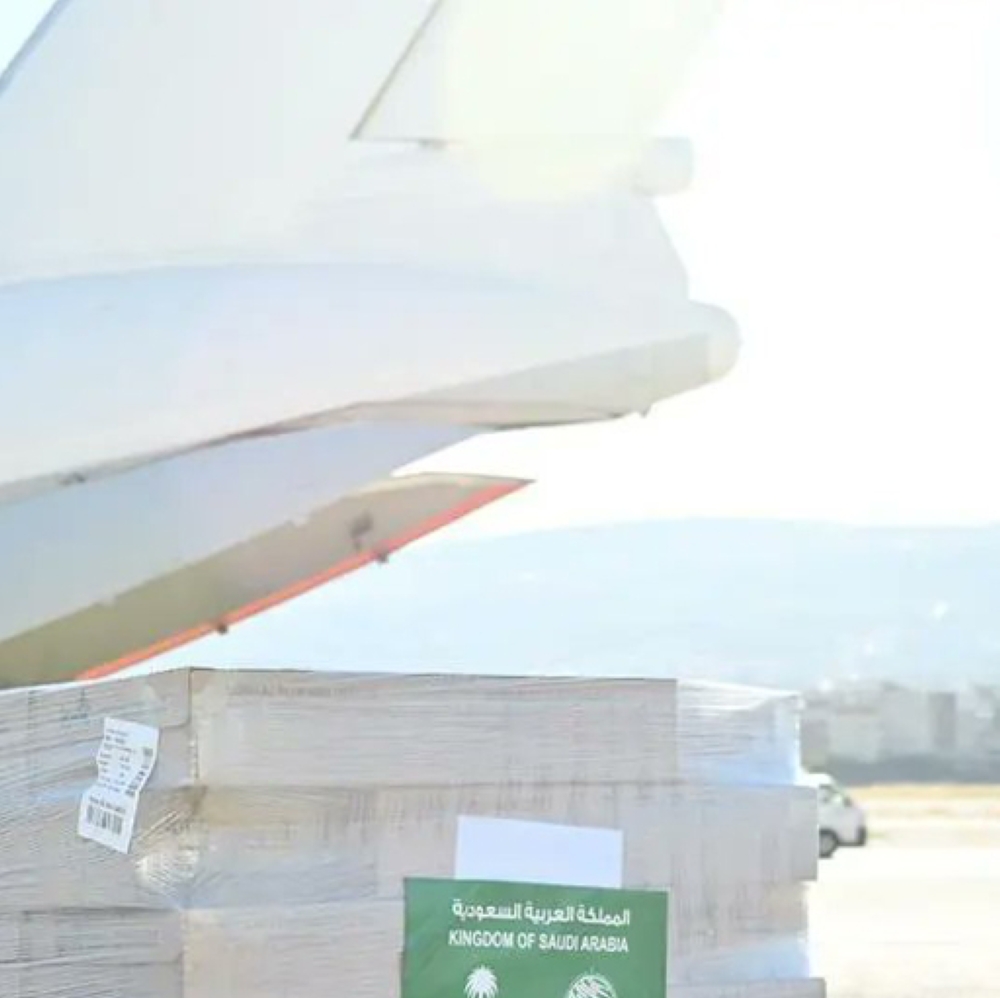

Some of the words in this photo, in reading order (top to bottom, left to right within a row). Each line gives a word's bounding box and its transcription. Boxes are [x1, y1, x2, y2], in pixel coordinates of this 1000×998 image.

[452, 898, 522, 921] السعودية
[524, 901, 575, 924] العربية
[576, 904, 630, 926] المملكة
[449, 929, 514, 948] KINGDOM
[517, 932, 536, 949] OF
[538, 933, 579, 951] SAUDI
[580, 935, 629, 953] ARABIA
